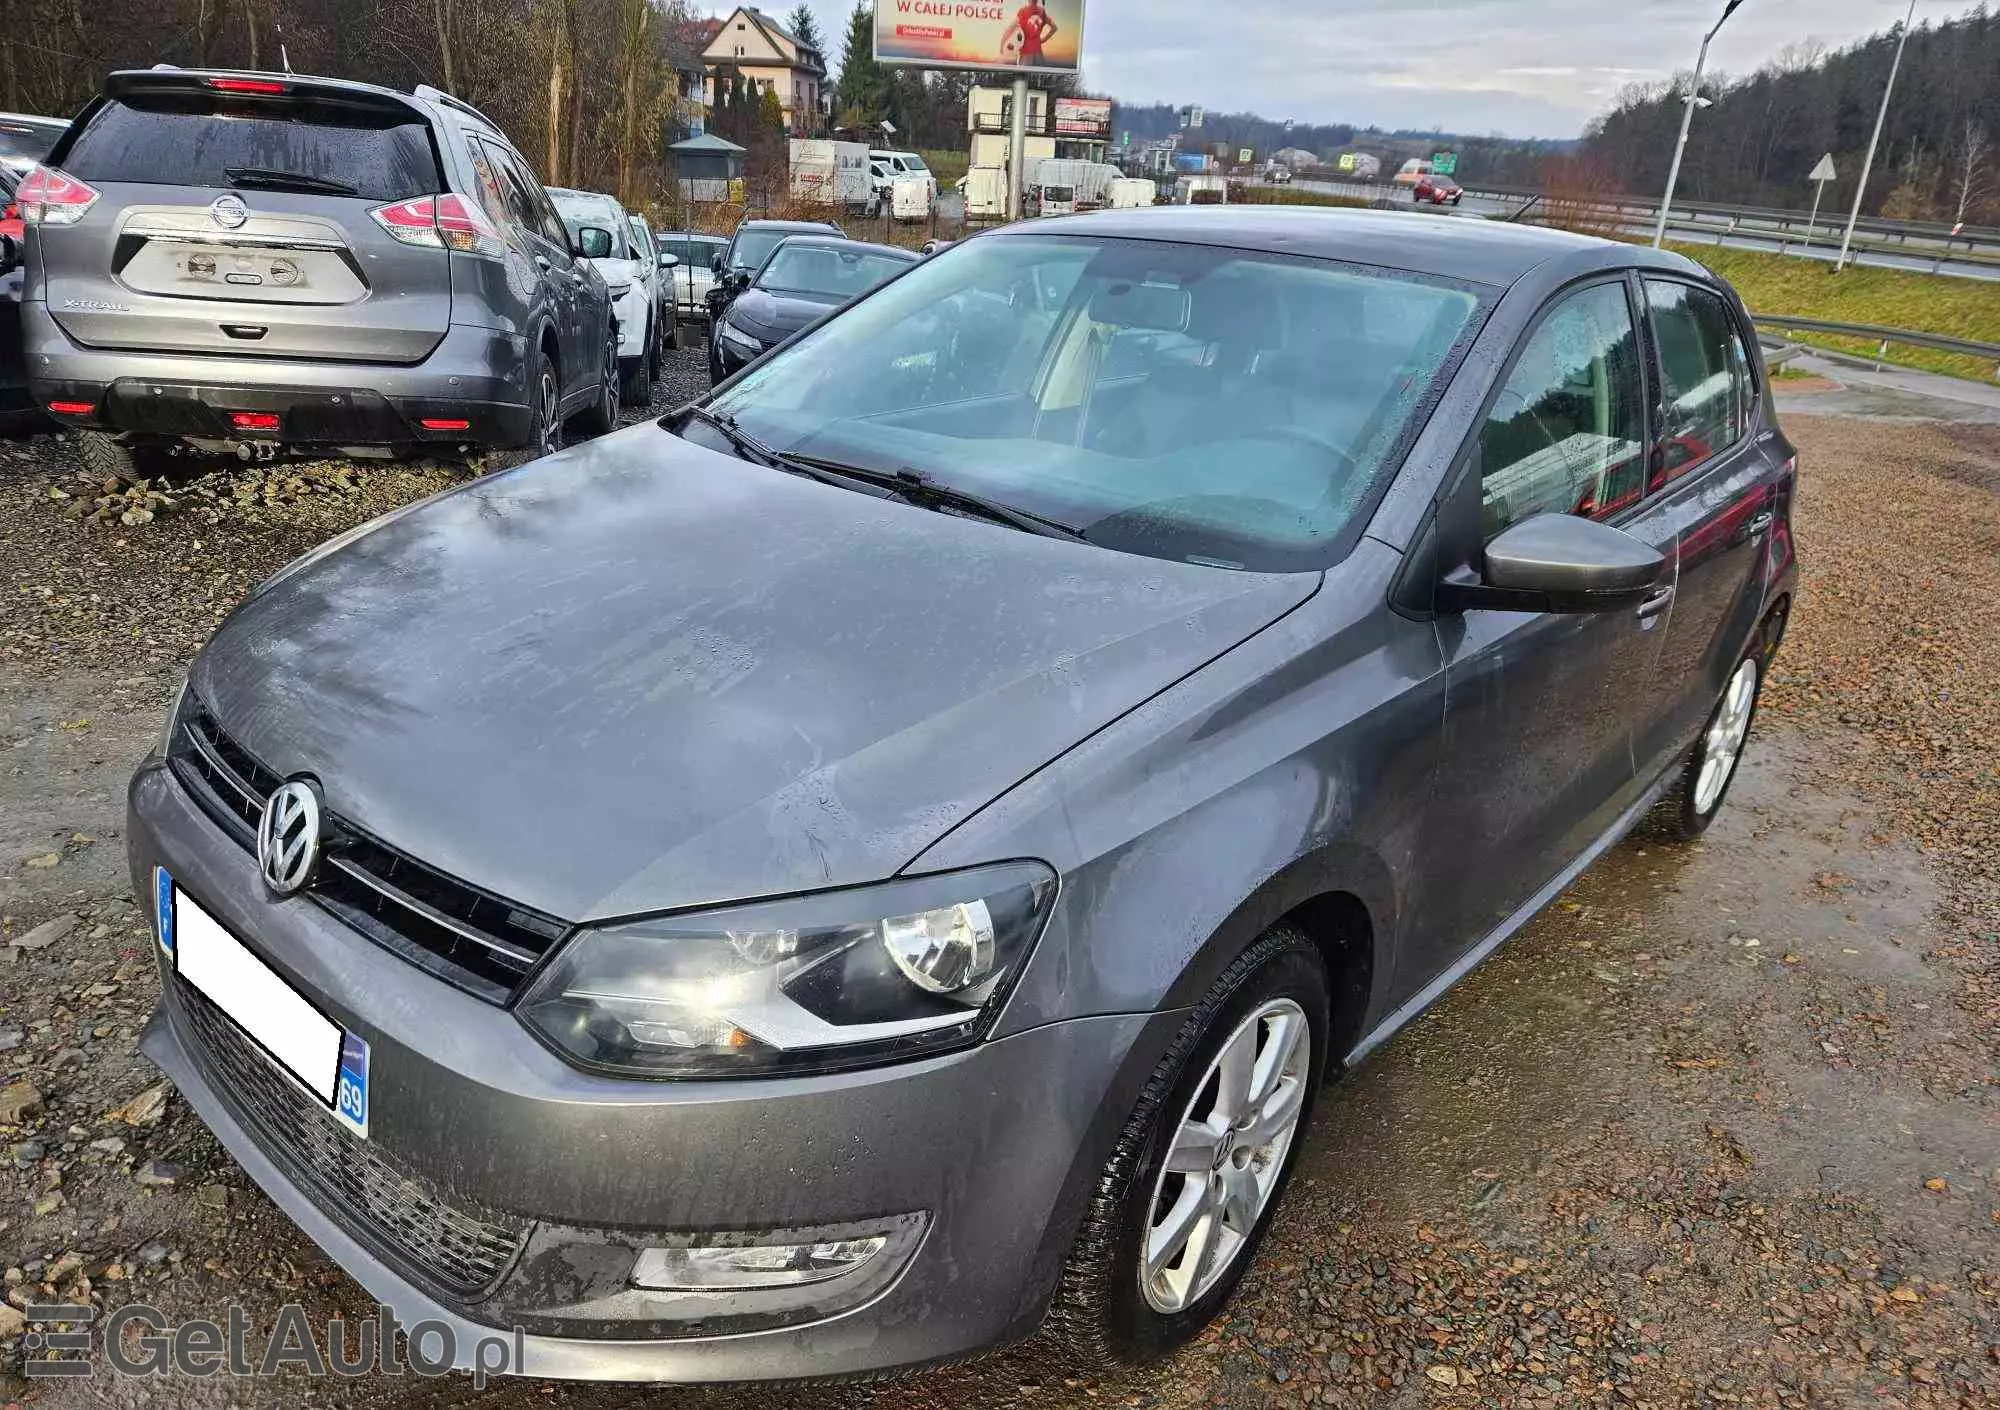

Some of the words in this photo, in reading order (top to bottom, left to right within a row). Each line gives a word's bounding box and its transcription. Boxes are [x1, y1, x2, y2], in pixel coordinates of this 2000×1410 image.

[897, 0, 911, 12] W
[914, 2, 952, 16] CAŁEJ
[955, 4, 1004, 20] POLSCE
[340, 1077, 363, 1118] 69
